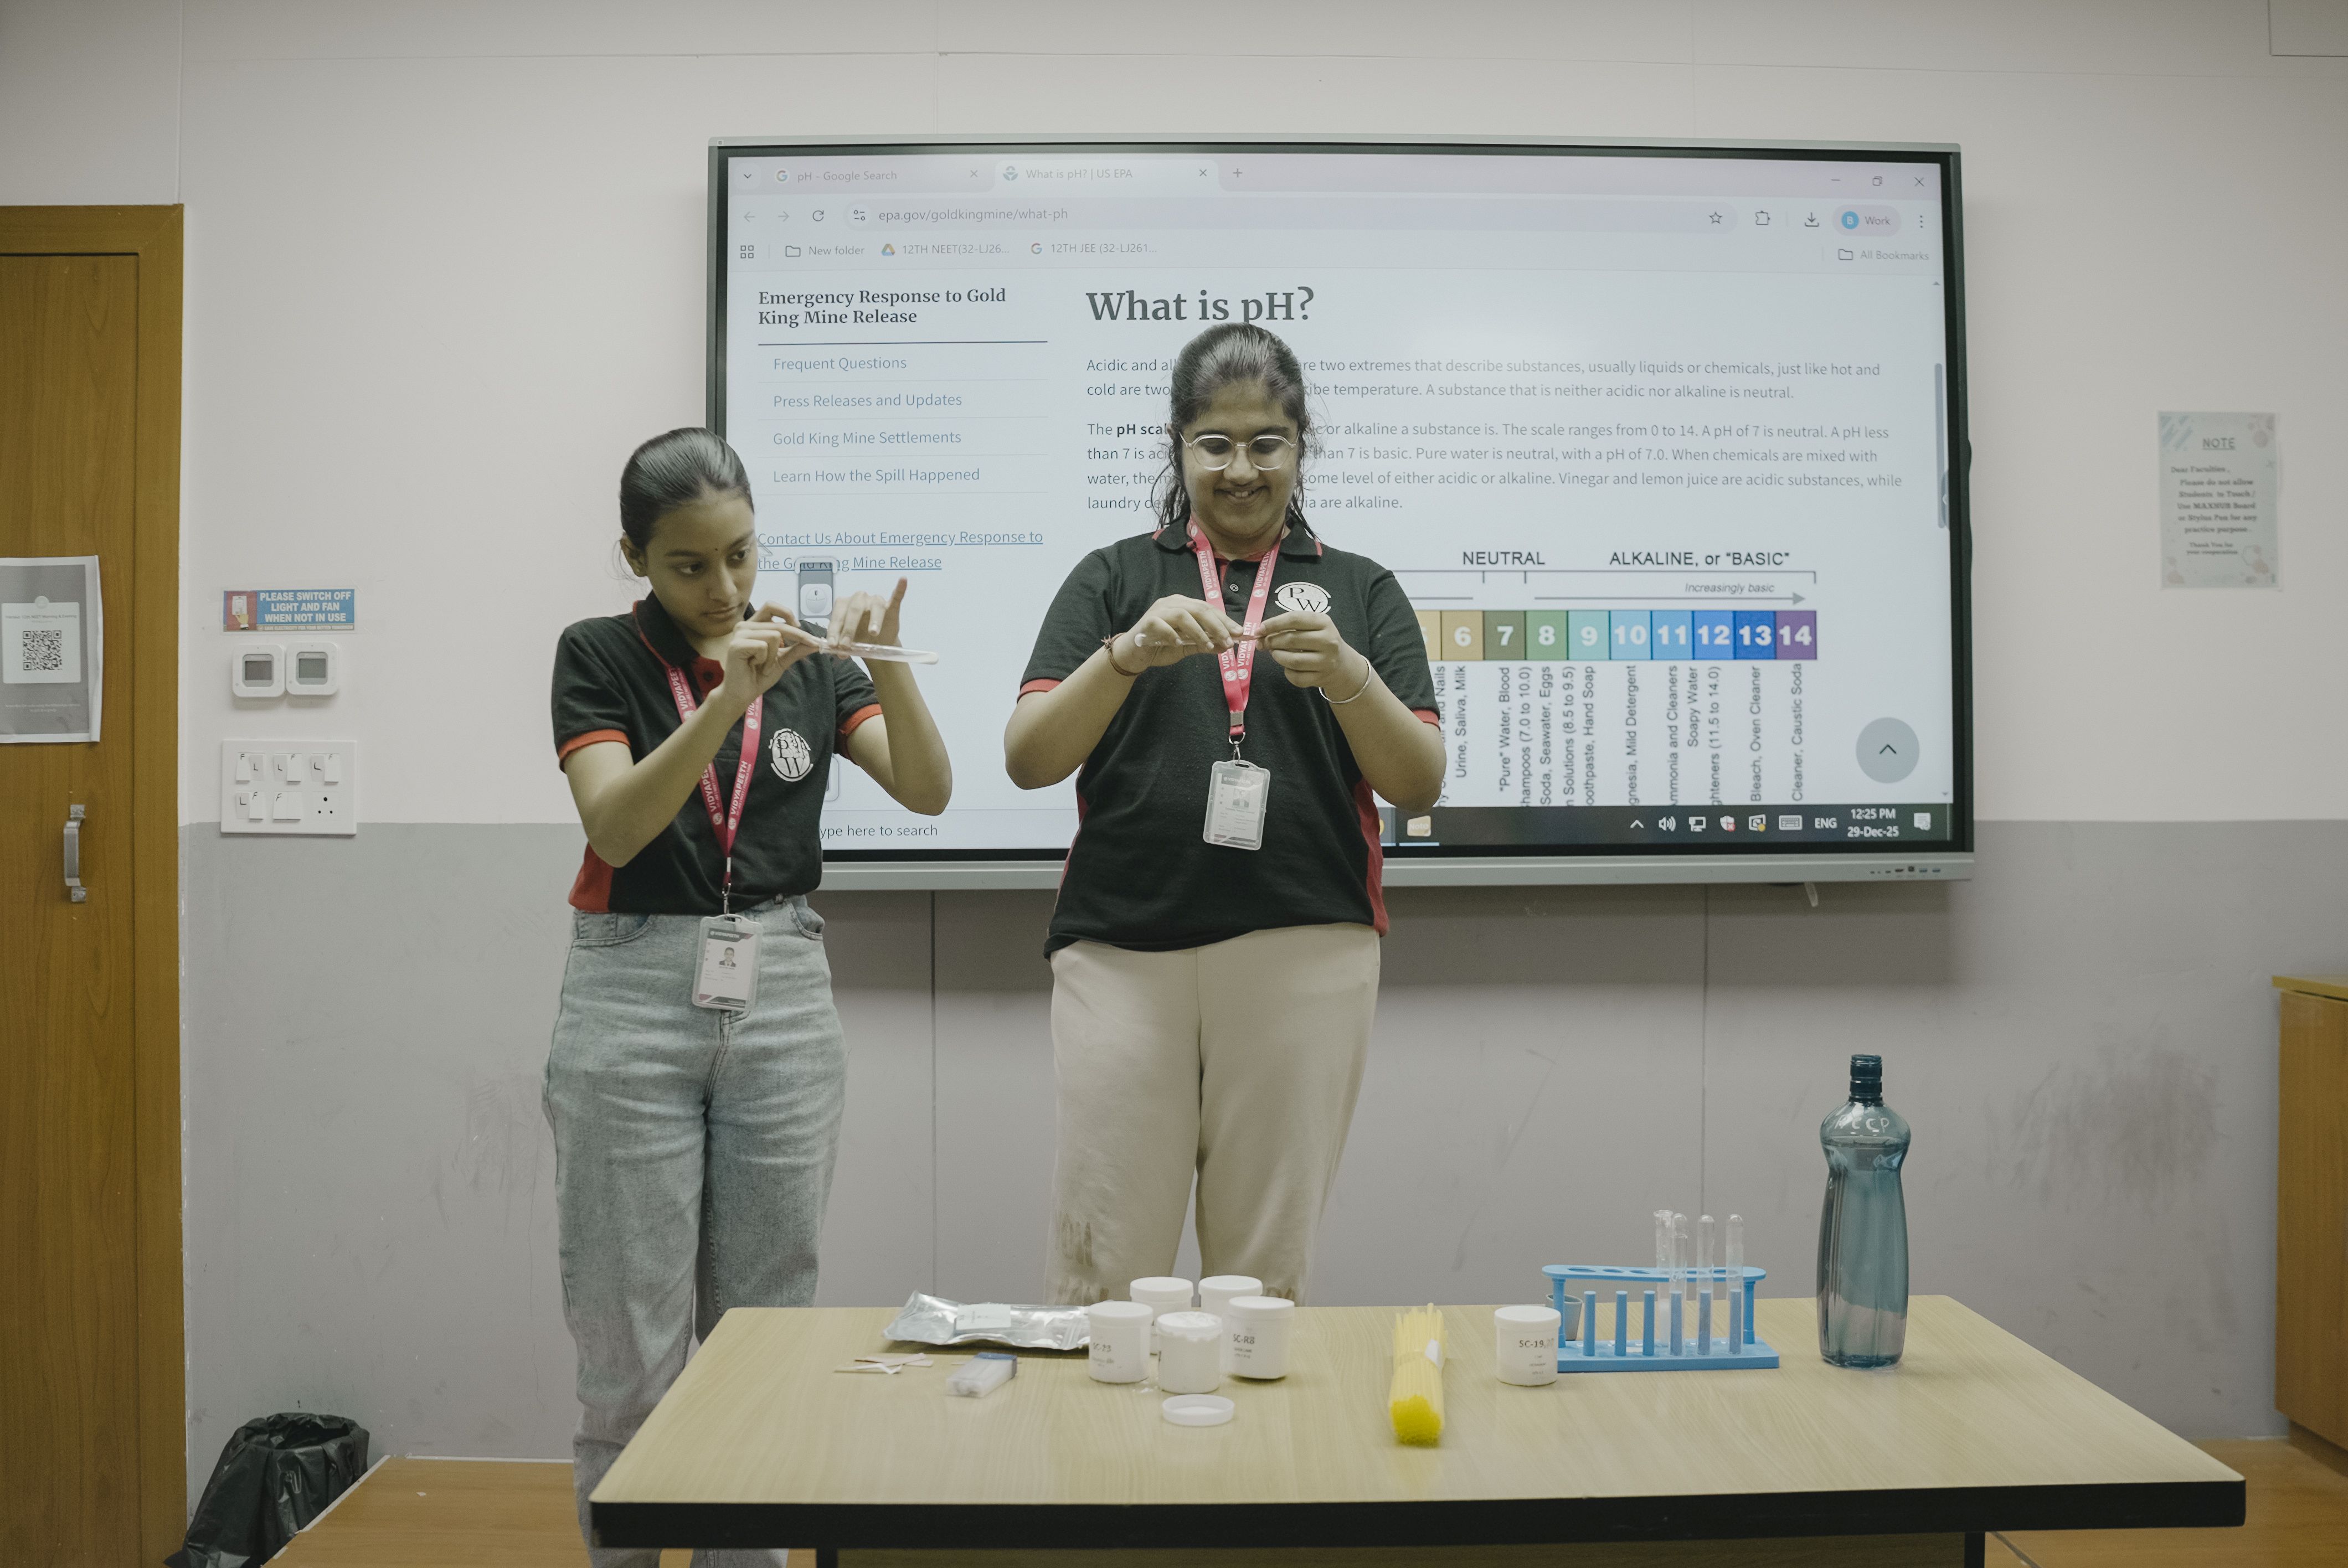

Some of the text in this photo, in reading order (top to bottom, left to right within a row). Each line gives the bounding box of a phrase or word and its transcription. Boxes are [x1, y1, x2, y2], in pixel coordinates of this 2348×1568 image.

[797, 171, 897, 183] pH Google Search
[1026, 169, 1053, 179] What
[1067, 169, 1088, 181] pH?
[1096, 169, 1111, 178] US
[1114, 168, 1133, 178] EPA
[878, 208, 1068, 224] epa.gov/goldkingmine/what-ph
[1865, 216, 1891, 225] Work
[809, 245, 865, 255] New folder
[903, 244, 928, 254] 12TH
[1051, 243, 1077, 253] 12TH
[1079, 243, 1096, 253] JEE
[1860, 250, 1929, 261] All Bookmarks
[759, 287, 1006, 308] Emergency Response to Gold
[1085, 286, 1315, 324] What is pH?
[759, 309, 917, 328] King Mine Release
[774, 357, 907, 373] Frequent Questions
[1087, 359, 1127, 371] Acidic
[1131, 359, 1156, 371] and
[1302, 360, 1316, 373] re
[1319, 360, 1345, 371] two
[1348, 360, 1411, 372] extremes
[1414, 359, 1443, 372] that
[1445, 359, 1503, 372] describe
[1507, 359, 1585, 374] substances,
[1588, 360, 1636, 376] usually
[1639, 360, 1684, 376] liquids
[1687, 364, 1702, 374] or
[1704, 361, 1774, 376] chemicals,
[1777, 362, 1801, 378] just
[1805, 363, 1827, 375] like
[1831, 363, 1852, 375] hot
[1856, 363, 1880, 376] and
[774, 393, 962, 409] Press Releases and Updates
[773, 431, 961, 448] Gold King Mine Settlements
[2202, 437, 2236, 449] NOTE
[774, 467, 980, 484] Learn How the Spill Happened
[1088, 496, 1403, 512] laundry are alkaline.
[758, 531, 1043, 546] Contact Us About Emergency Response to
[758, 557, 780, 569] the
[853, 556, 886, 569] Mine
[890, 555, 942, 568] Release
[1463, 551, 1546, 565] NEUTRAL
[1609, 551, 1789, 567] ALKALINE, or "BASIC"
[1199, 550, 1212, 590] VIDYAPEETH
[259, 591, 352, 601] PLEASE SWITCH OFF
[1685, 583, 1775, 595] Increasingly basic
[271, 602, 340, 612] LIGHT AND FAN
[264, 612, 346, 623] WHEN NOT IN USE
[1454, 625, 1813, 647] 6 7 8 9 10 11 12 13 14
[1687, 667, 1701, 747] Soapy Water
[1454, 666, 1468, 778] Urine, Saliva, Milk
[1498, 667, 1511, 792] "Pure" Water, Blood
[1518, 667, 1533, 804] hampoos (7.0 to 10.0)
[1539, 666, 1553, 806] Soda, Seawater, Eggs
[1582, 666, 1597, 806] oothpaste, Hand Soap
[1749, 666, 1762, 802] Bleach, Oven Cleaner
[1790, 663, 1804, 802] Cleaner, Caustic Soda
[730, 760, 748, 815] VIDYAPEETH
[1851, 808, 1896, 820] 12:25 PM
[1814, 817, 1837, 829] ENG
[820, 824, 938, 840] ype here to search
[1847, 826, 1899, 838] 29-Dec-25
